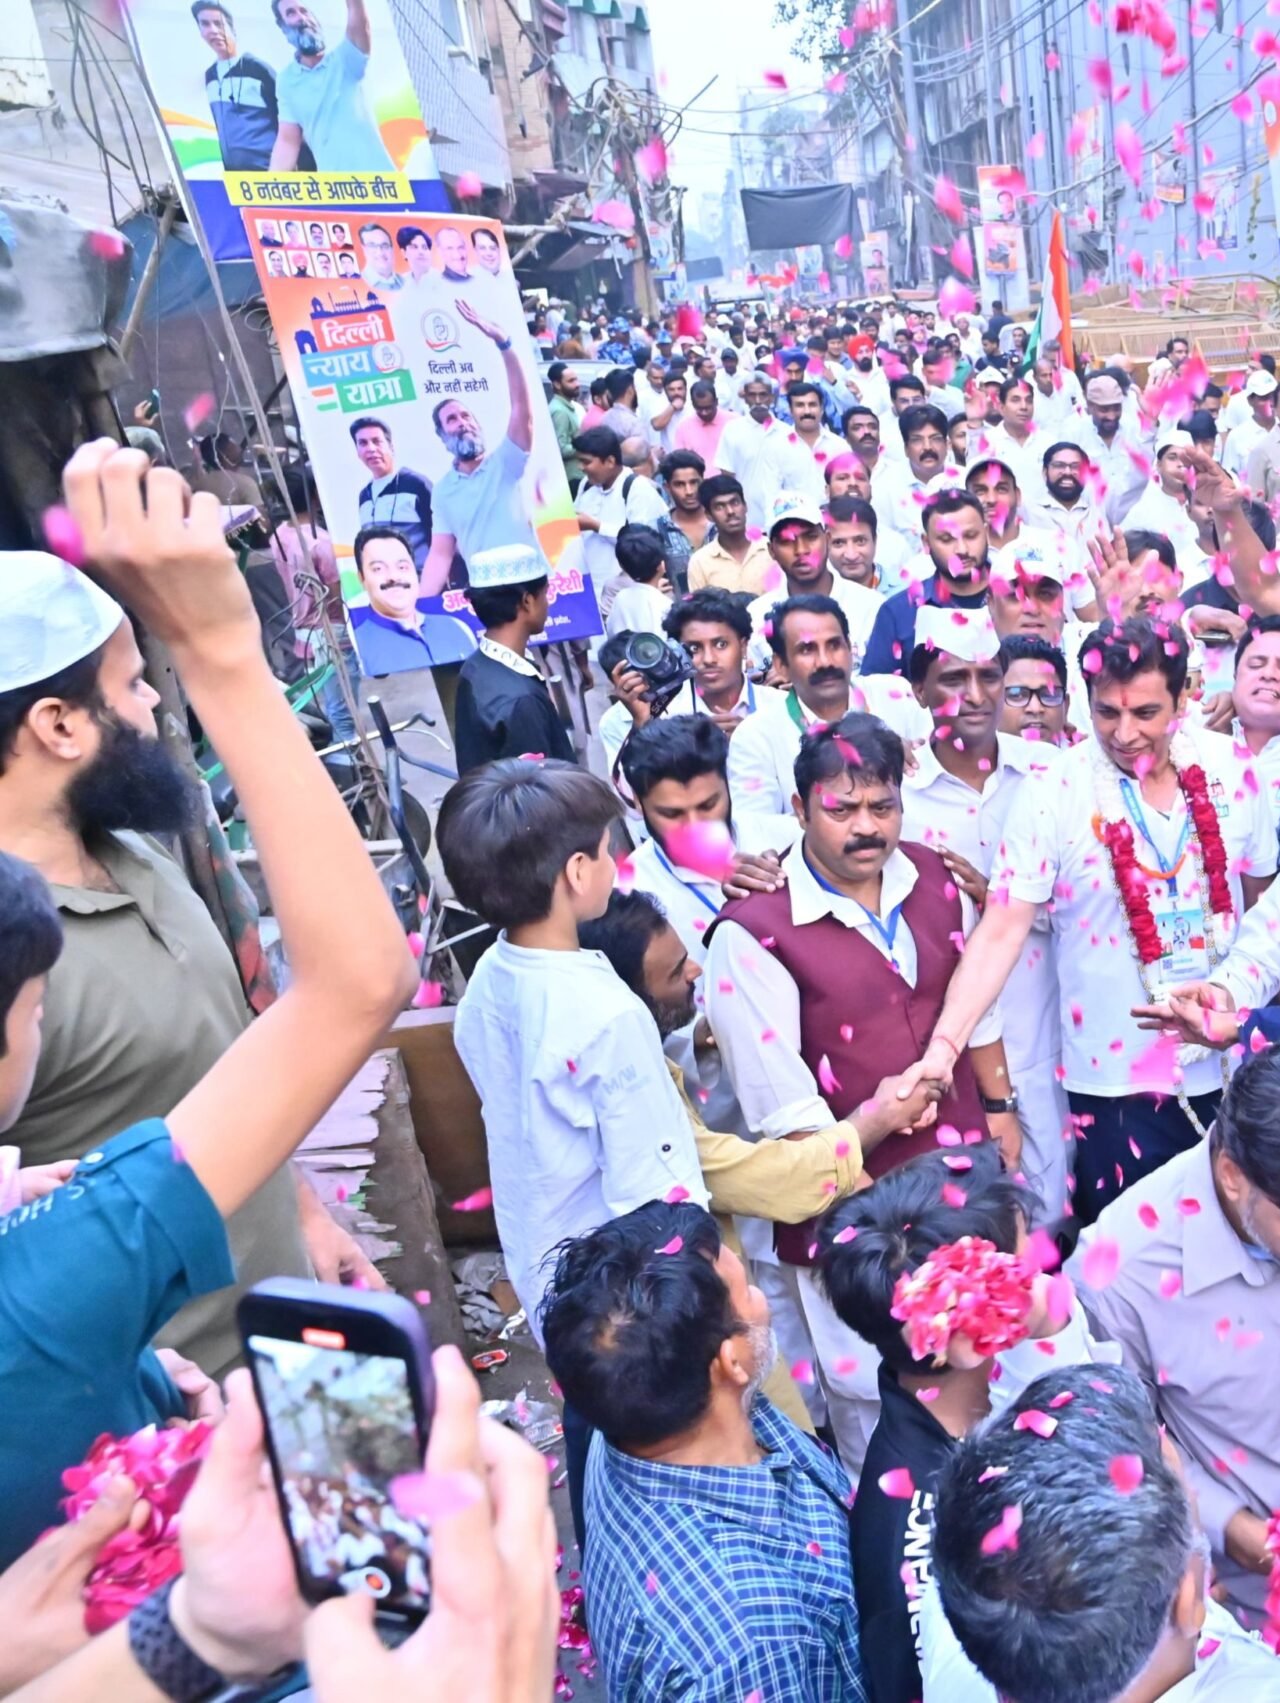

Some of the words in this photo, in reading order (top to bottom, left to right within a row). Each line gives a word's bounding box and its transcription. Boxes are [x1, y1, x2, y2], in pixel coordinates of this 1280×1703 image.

[253, 177, 302, 201] नवंबर
[303, 176, 322, 200] से
[324, 176, 369, 200] आपके
[369, 175, 399, 199] बीच
[321, 313, 386, 347] दिल्ली
[305, 350, 371, 377] न्याय
[428, 359, 457, 374] दिल्ली
[459, 362, 474, 374] अब
[343, 376, 403, 405] यात्रा
[424, 379, 442, 393] और
[463, 377, 489, 392] सहेगी
